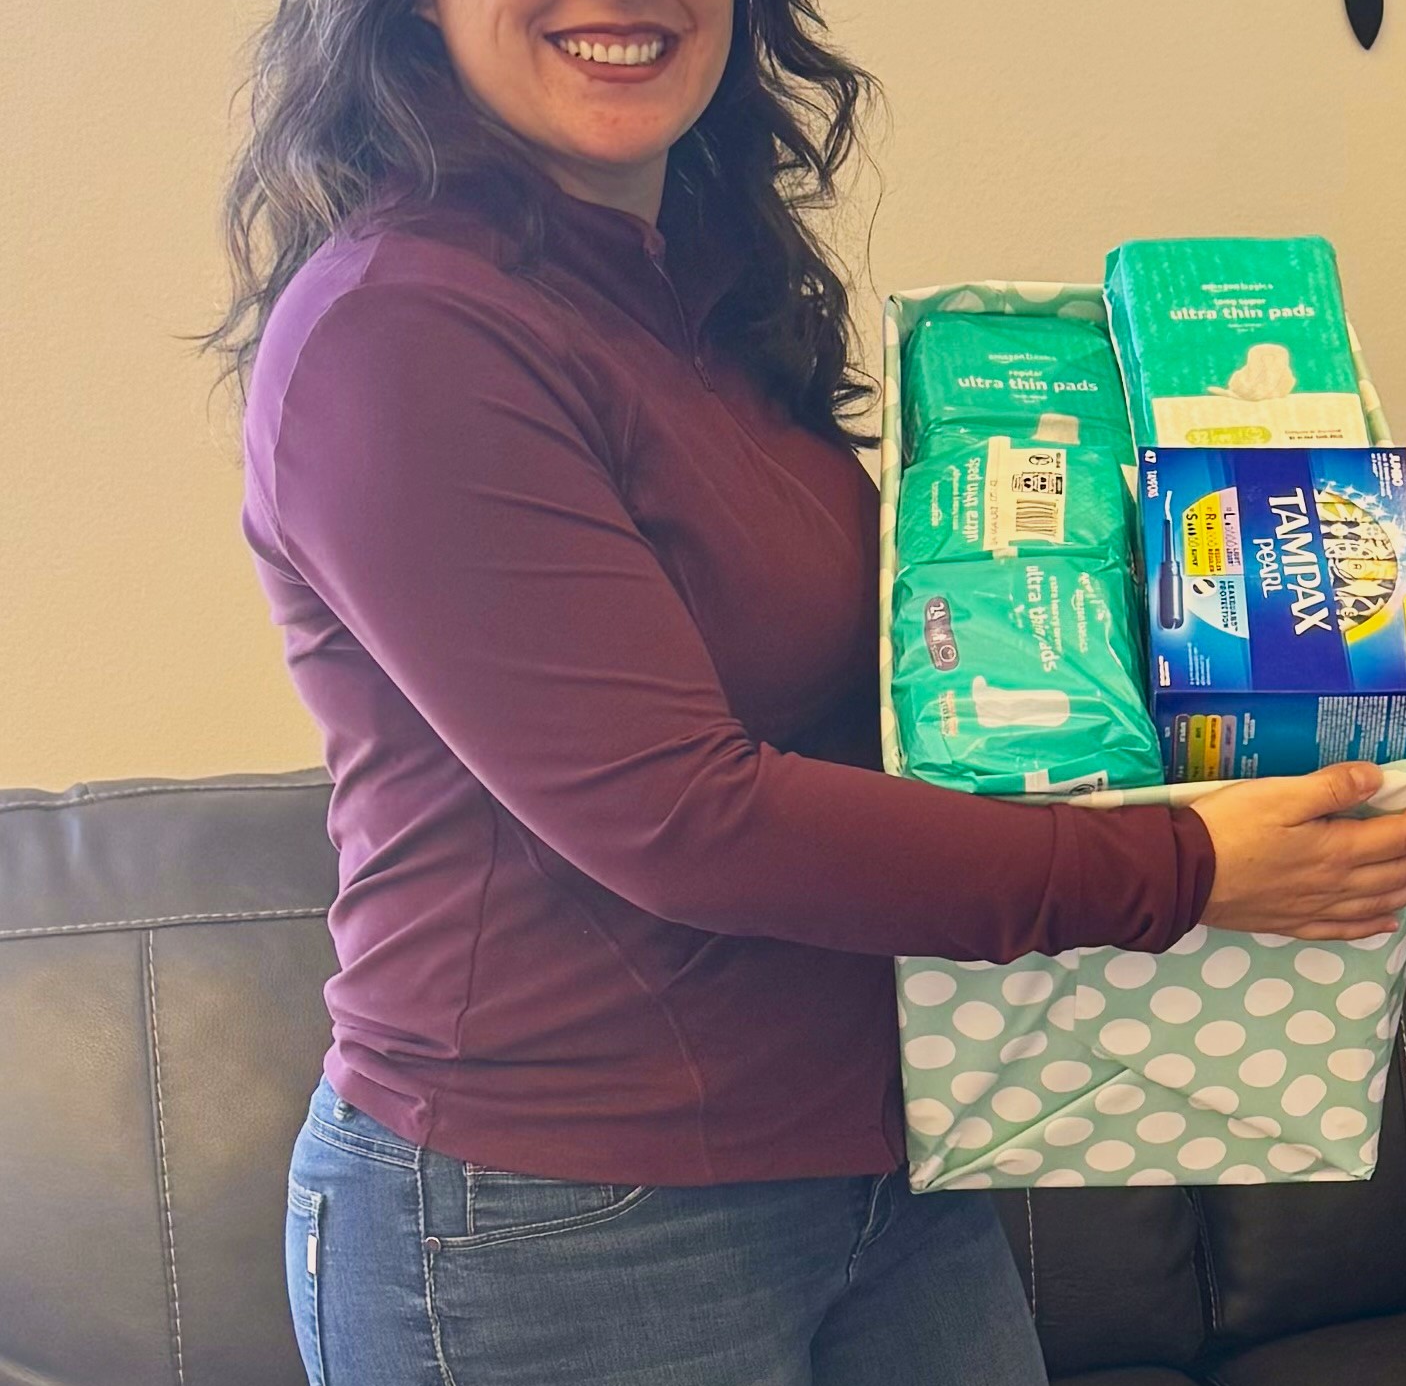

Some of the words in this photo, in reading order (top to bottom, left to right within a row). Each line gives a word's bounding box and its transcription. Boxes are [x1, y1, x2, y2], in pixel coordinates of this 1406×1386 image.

[1170, 306, 1218, 320] ultra
[1222, 305, 1263, 319] thin
[1268, 303, 1315, 321] pads
[957, 375, 1004, 389] ultra
[1008, 377, 1048, 391] thin
[1053, 380, 1099, 393] pads
[965, 457, 984, 481] pads
[1388, 453, 1404, 487] JUMBO
[962, 483, 979, 508] thin
[962, 511, 979, 543] ultra
[1268, 487, 1332, 635] TAMPAX
[1025, 565, 1044, 603] ultra
